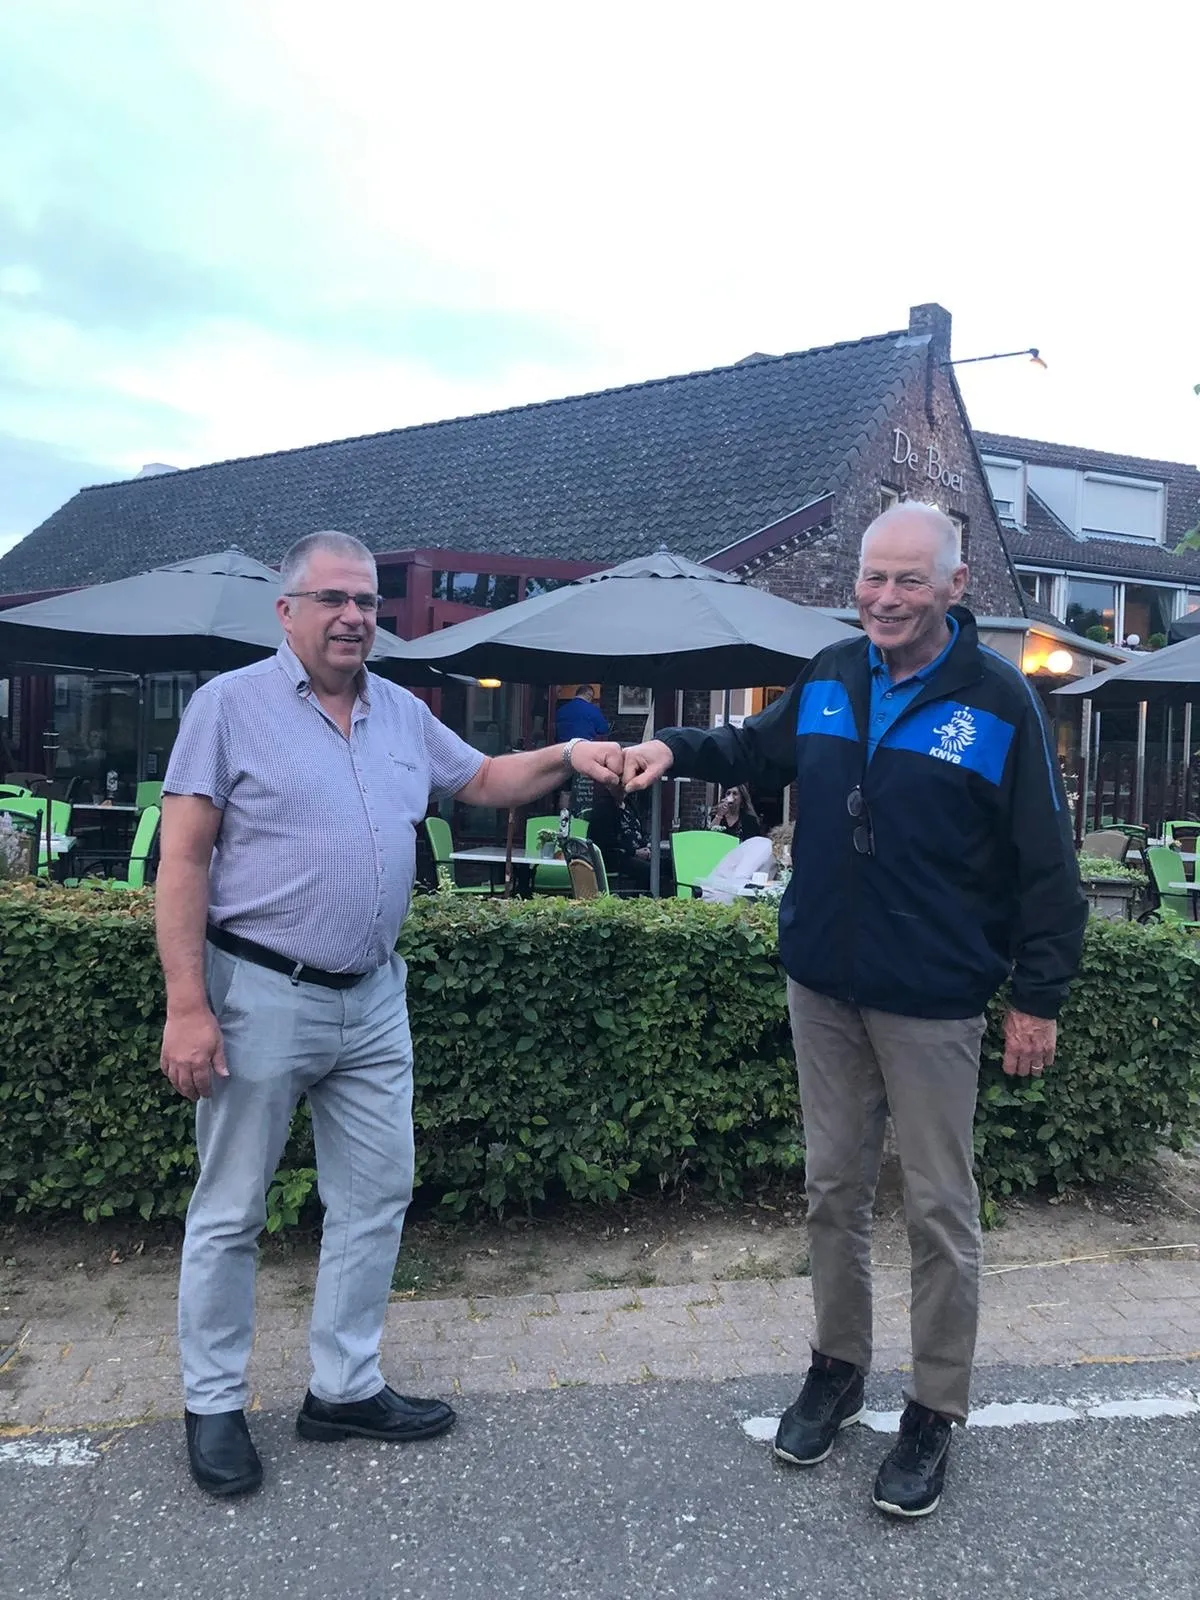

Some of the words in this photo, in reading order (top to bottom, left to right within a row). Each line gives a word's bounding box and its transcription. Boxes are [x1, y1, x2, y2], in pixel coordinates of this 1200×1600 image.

[893, 428, 918, 471] De
[927, 446, 963, 492] Boei
[929, 746, 961, 764] KNVB
